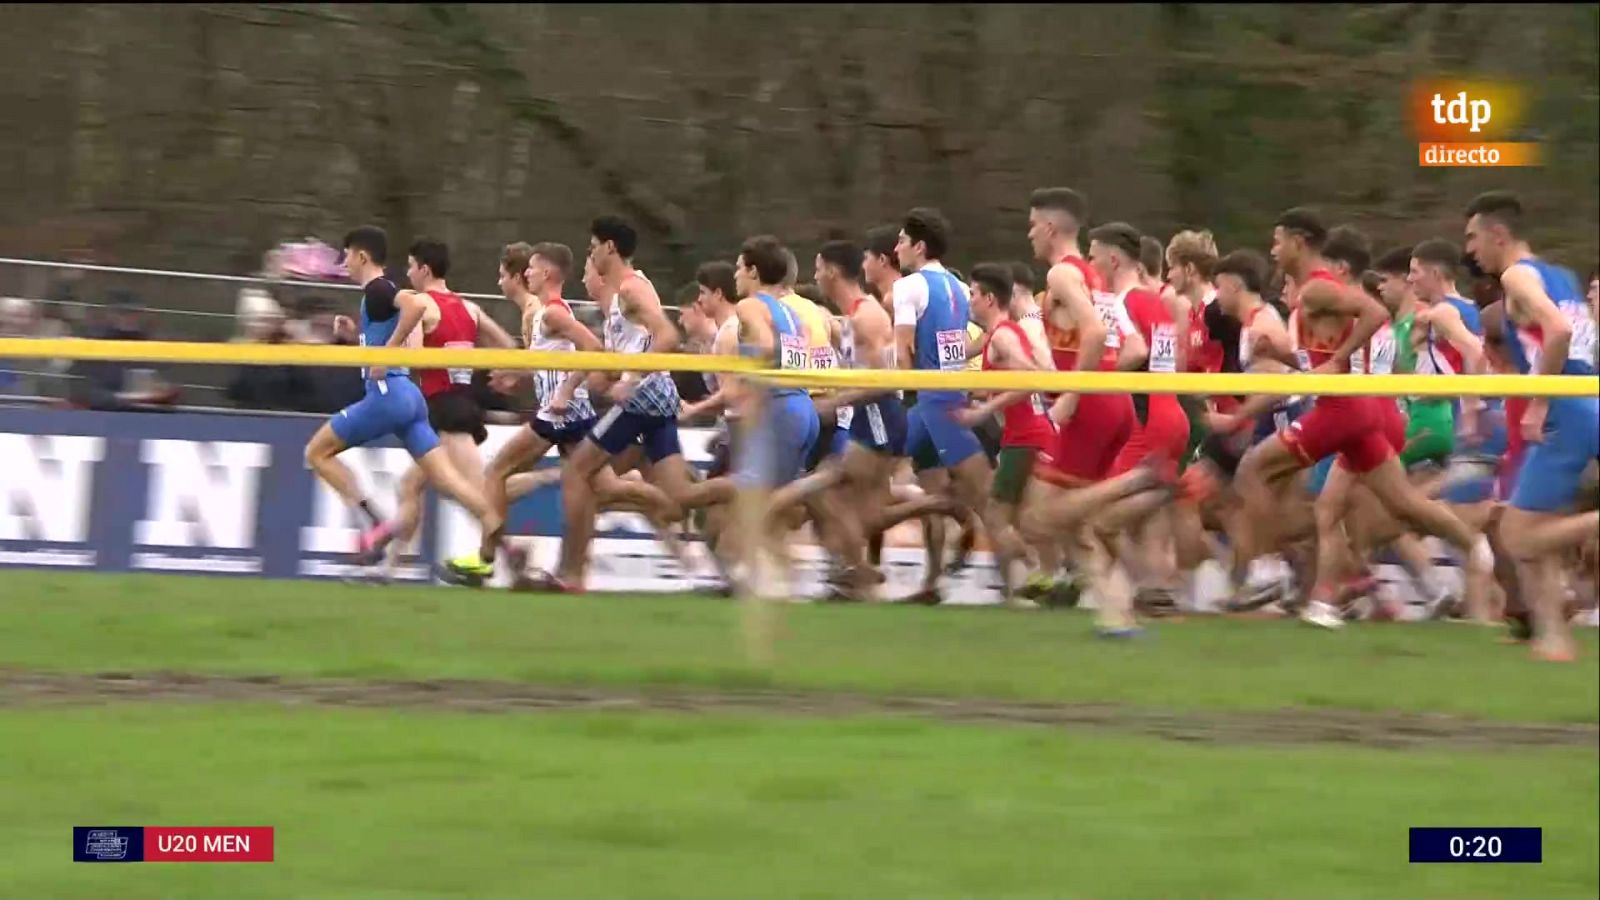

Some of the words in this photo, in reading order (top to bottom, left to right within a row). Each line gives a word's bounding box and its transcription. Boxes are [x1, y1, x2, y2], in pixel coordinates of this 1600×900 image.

[787, 349, 807, 368] 307
[944, 344, 964, 360] 304
[133, 438, 272, 549] N
